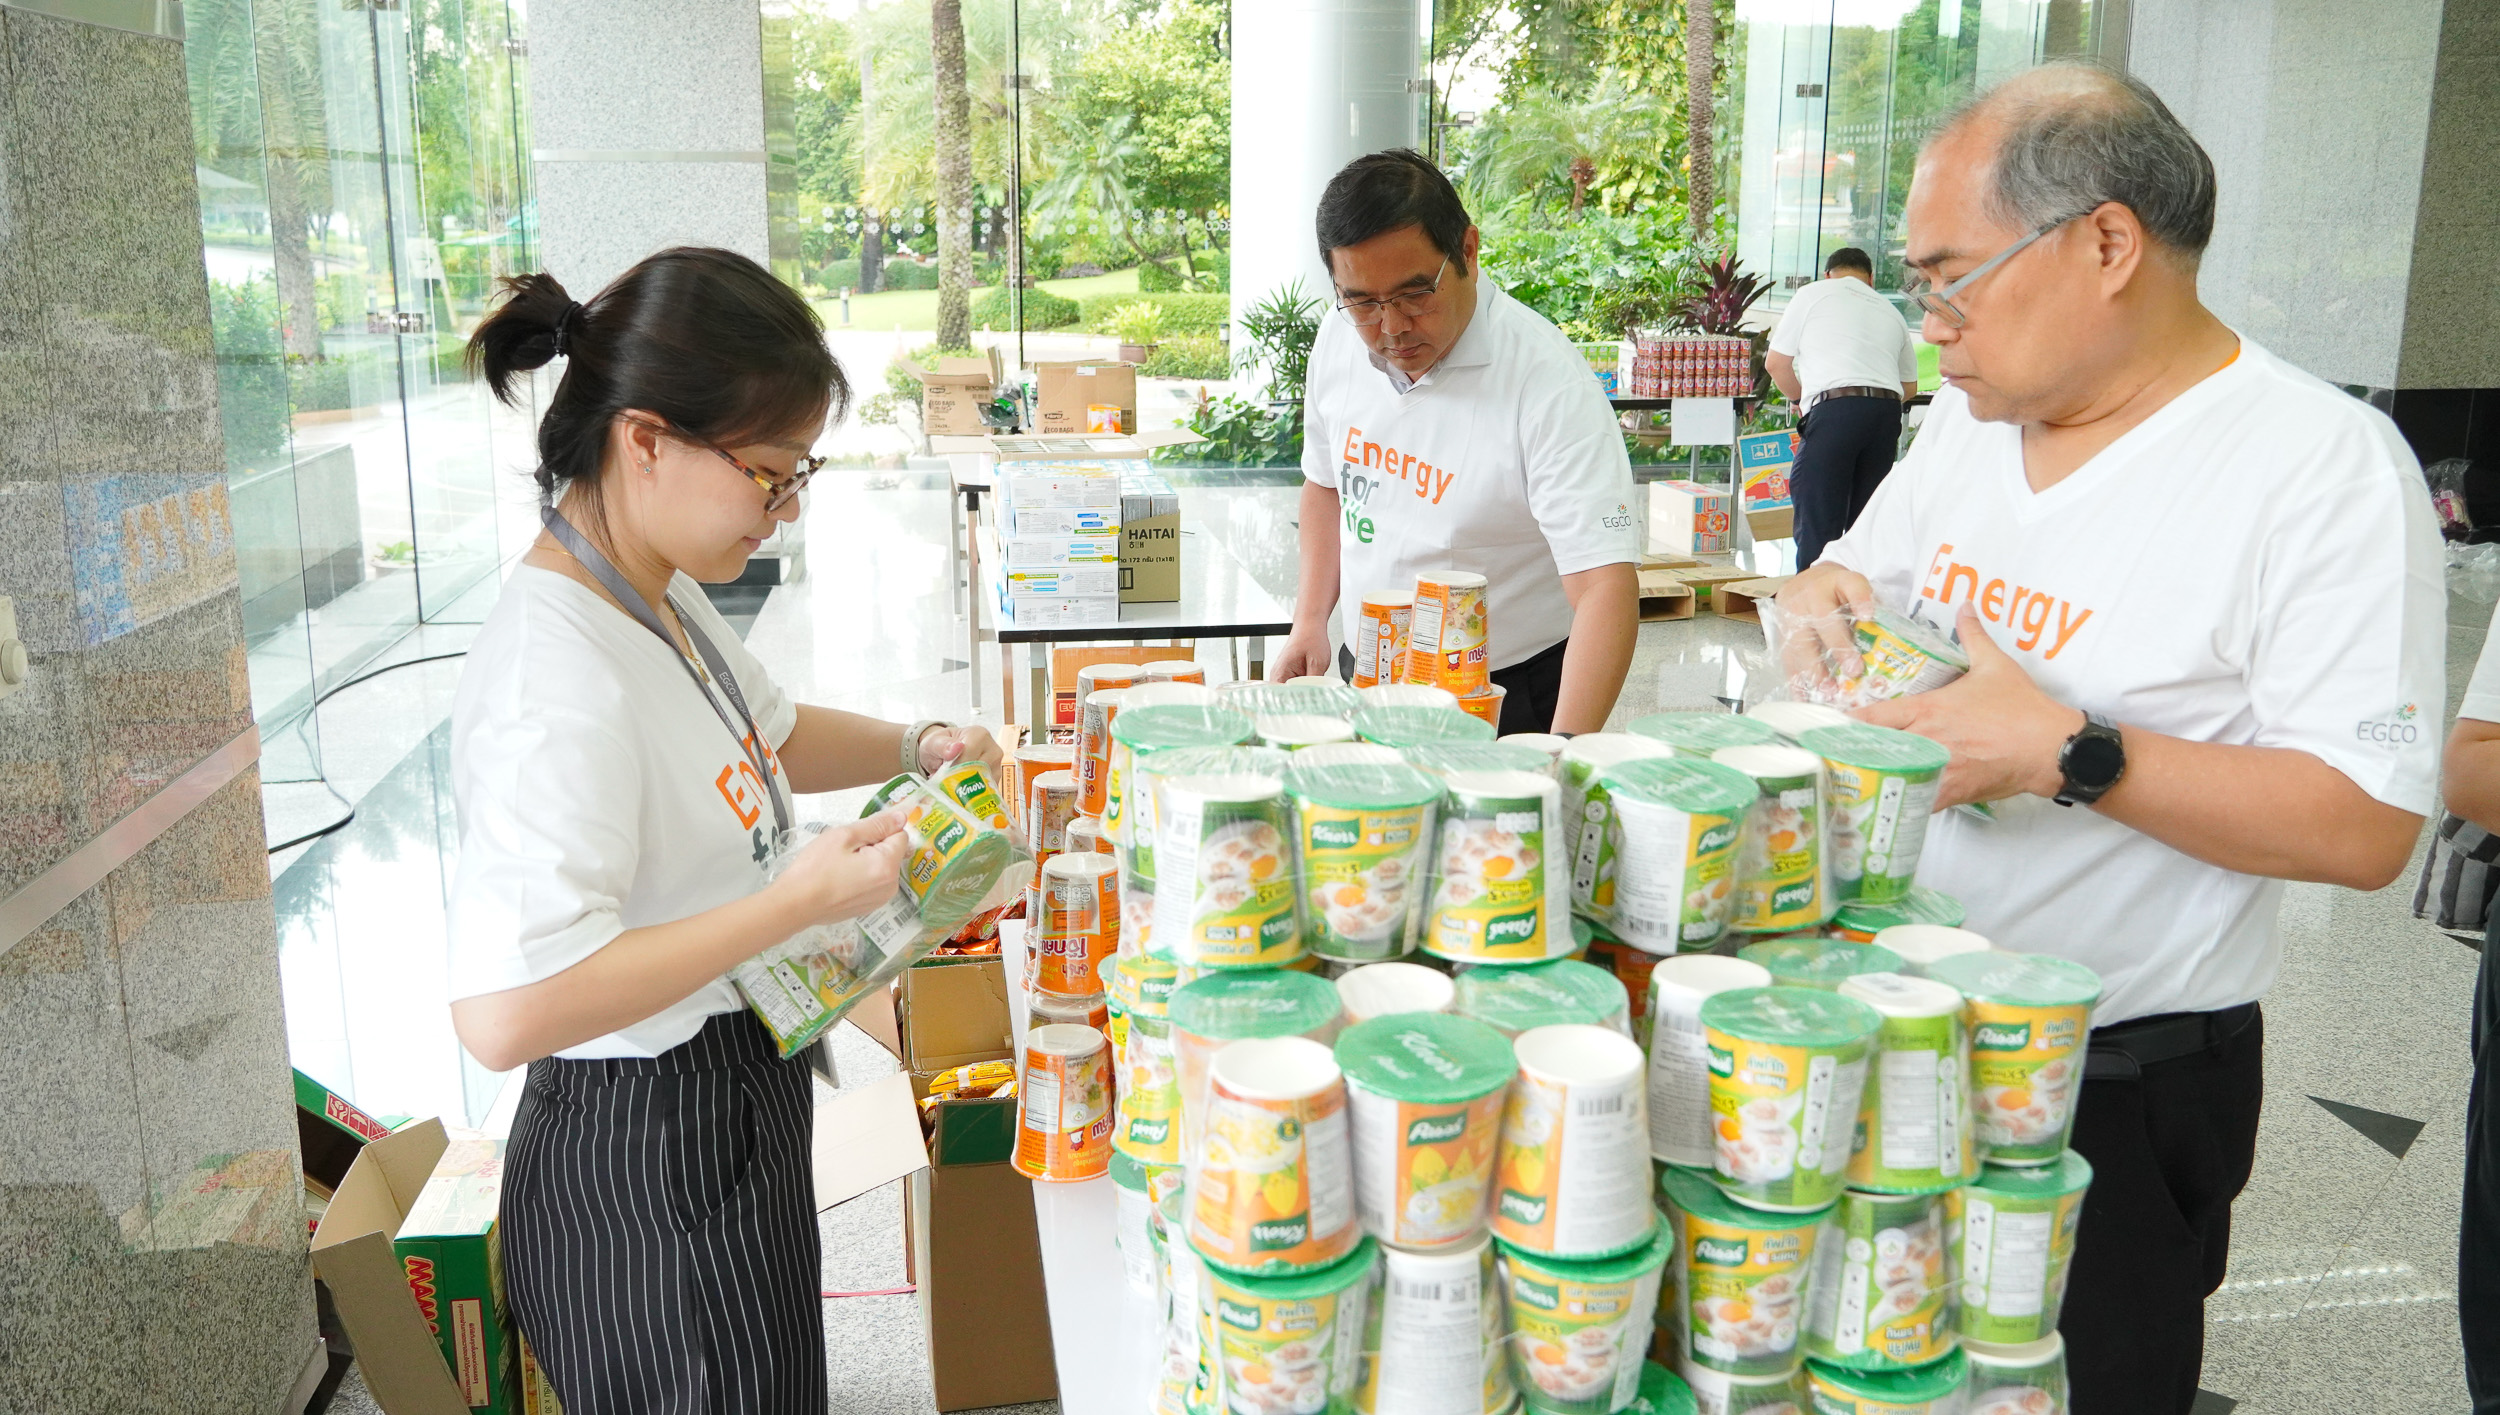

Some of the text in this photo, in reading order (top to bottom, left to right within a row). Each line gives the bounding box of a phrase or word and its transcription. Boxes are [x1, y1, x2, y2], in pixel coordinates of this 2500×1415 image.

[1343, 426, 1454, 505] Energy
[1341, 463, 1380, 506] for
[1602, 515, 1632, 528] EGCO
[1128, 528, 1175, 541] HAITAI
[1921, 543, 2094, 660] Energy
[718, 671, 736, 695] EGCO
[2356, 721, 2417, 744] EGCO
[956, 781, 986, 798] Knorr
[1311, 823, 1358, 844] Knorr
[544, 1405, 552, 1414] 30
